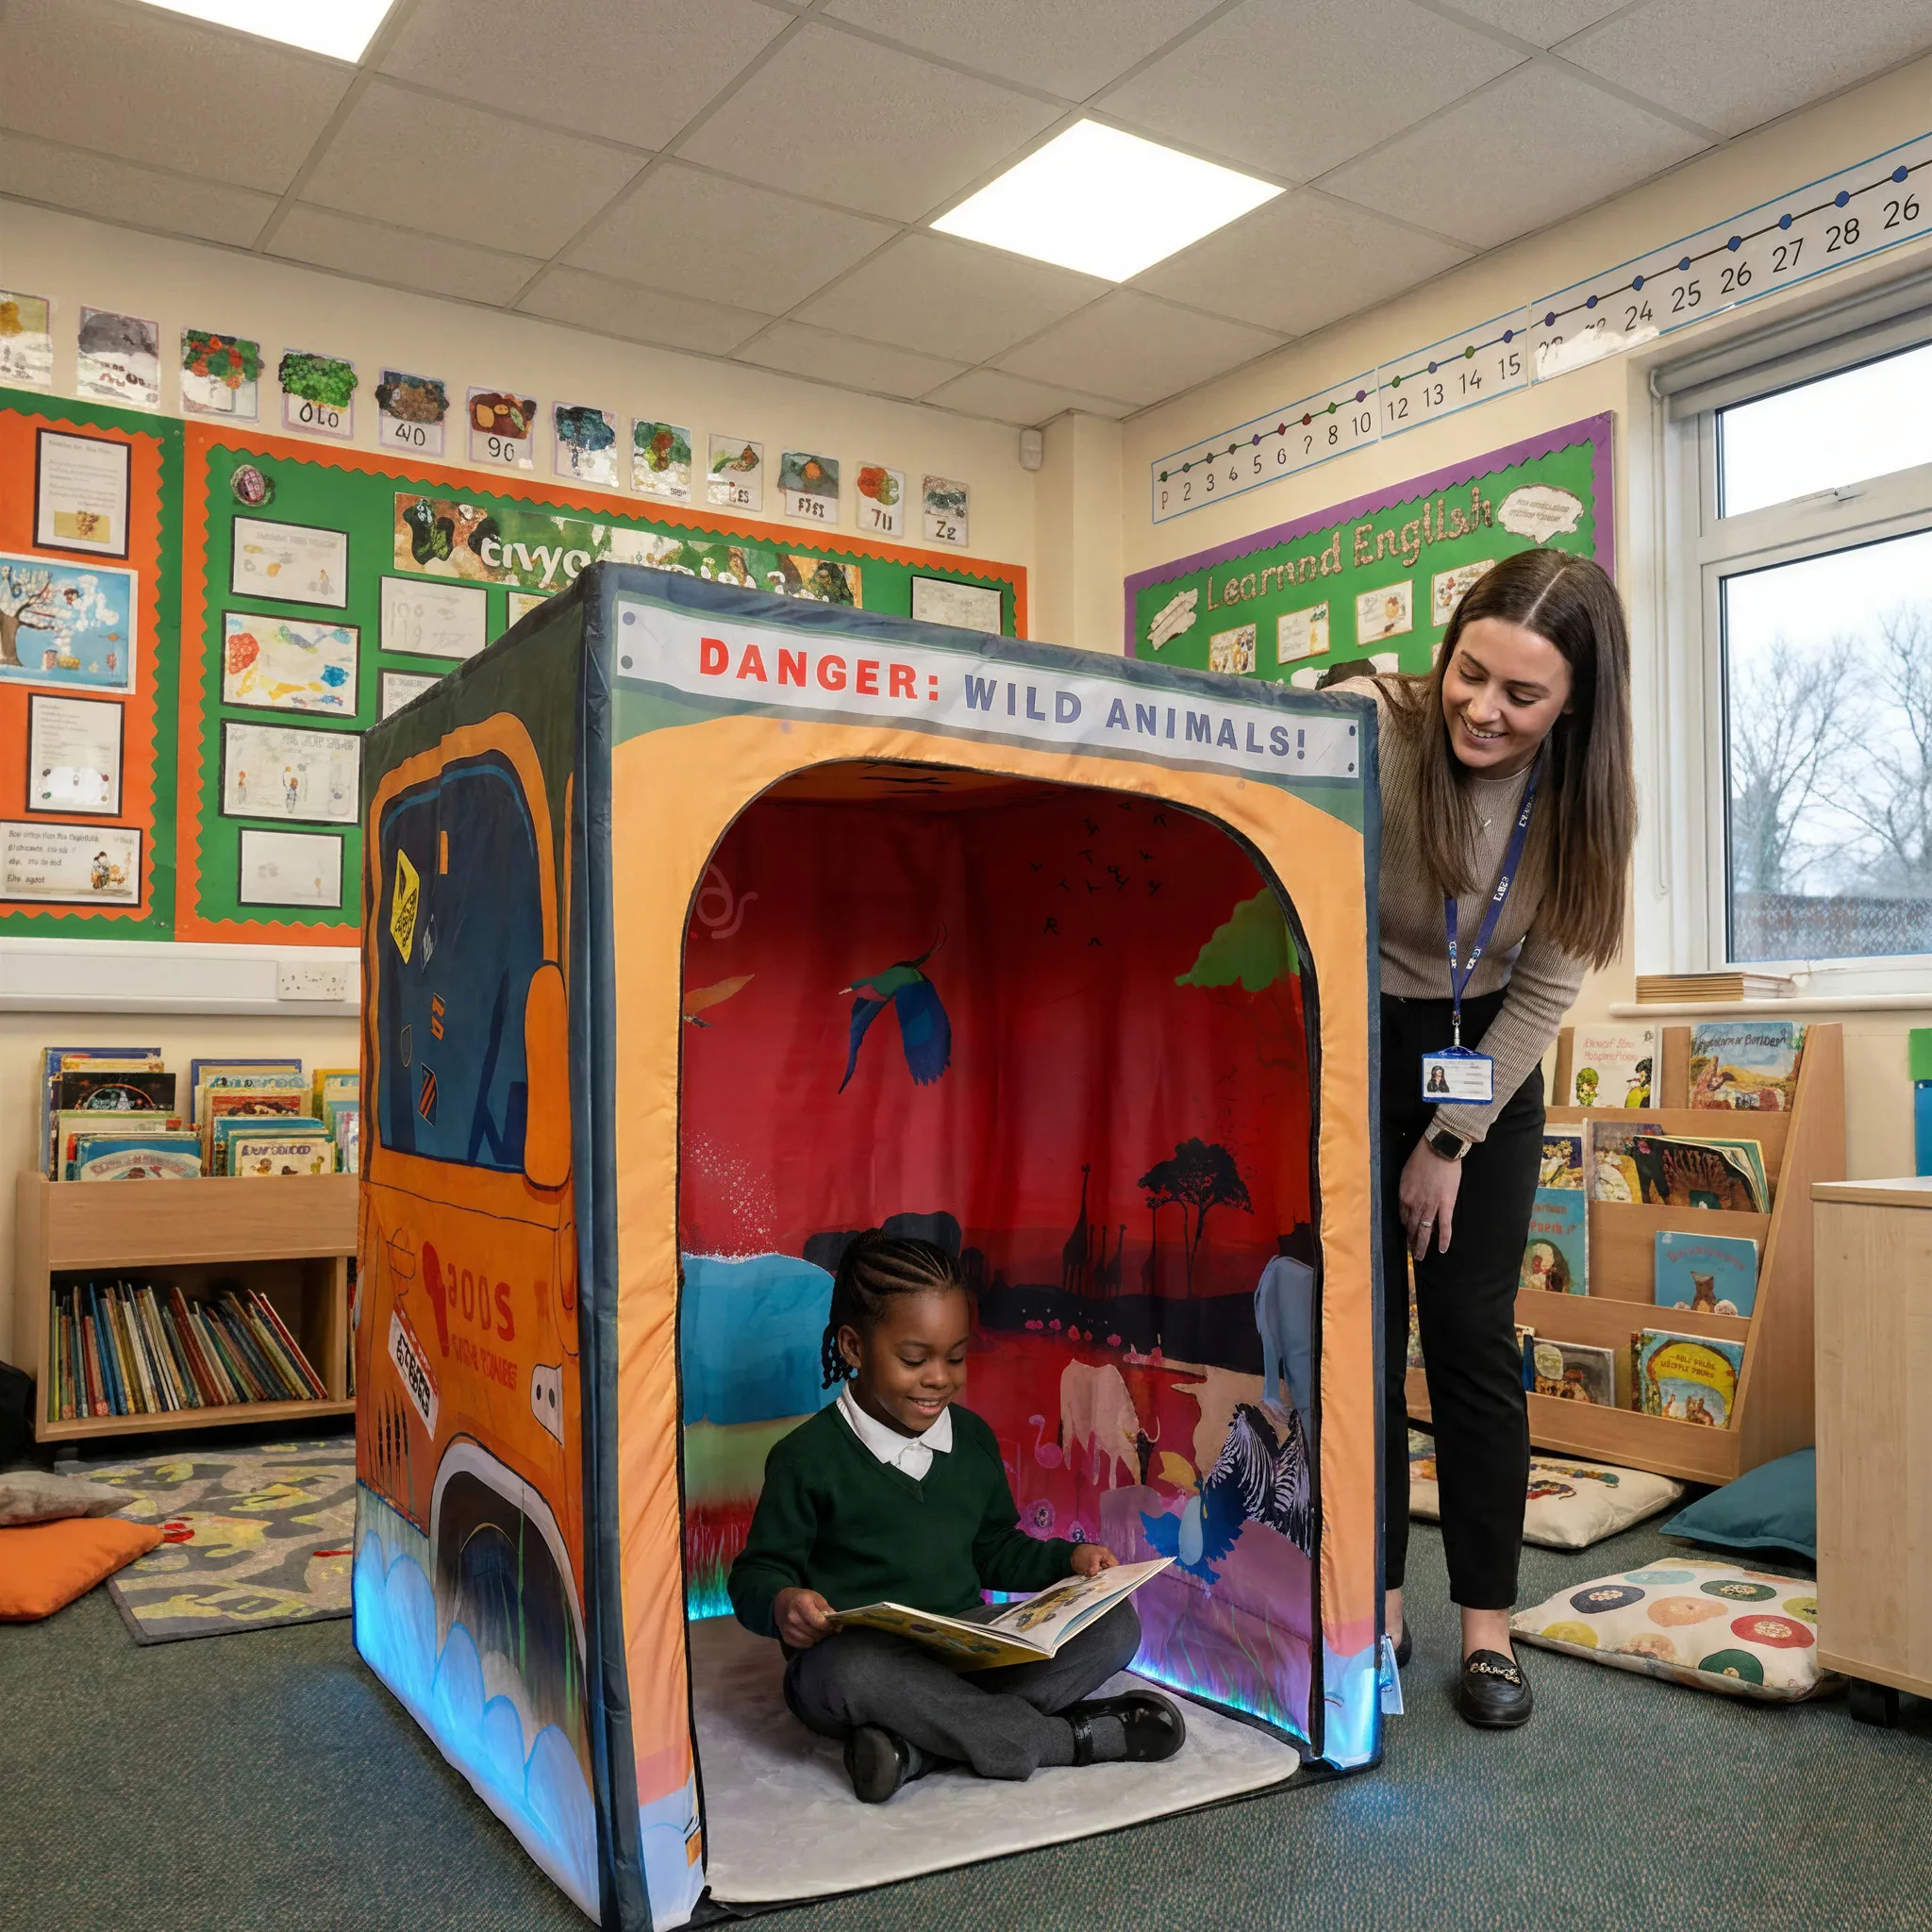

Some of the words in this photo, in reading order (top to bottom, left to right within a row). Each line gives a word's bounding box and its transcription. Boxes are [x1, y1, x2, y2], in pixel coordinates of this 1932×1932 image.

[1624, 300, 1653, 332] 24
[1672, 279, 1701, 313] 25
[1721, 262, 1752, 294] 26
[1773, 238, 1804, 274] 27
[1826, 218, 1860, 253] 28
[1883, 193, 1920, 230] 26
[1387, 397, 1409, 423] 12
[1423, 384, 1444, 408] 13
[1458, 369, 1483, 394] 14
[1497, 353, 1521, 380] 15
[1183, 482, 1191, 502] 2
[1206, 474, 1216, 491] 3
[1253, 454, 1263, 475] 5
[1276, 448, 1287, 465] 6
[1327, 425, 1339, 445] 8
[1352, 411, 1373, 437] 10
[699, 637, 940, 702] DANGER:
[964, 675, 1082, 724] WILD
[1106, 698, 1306, 760] ANIMALS!
